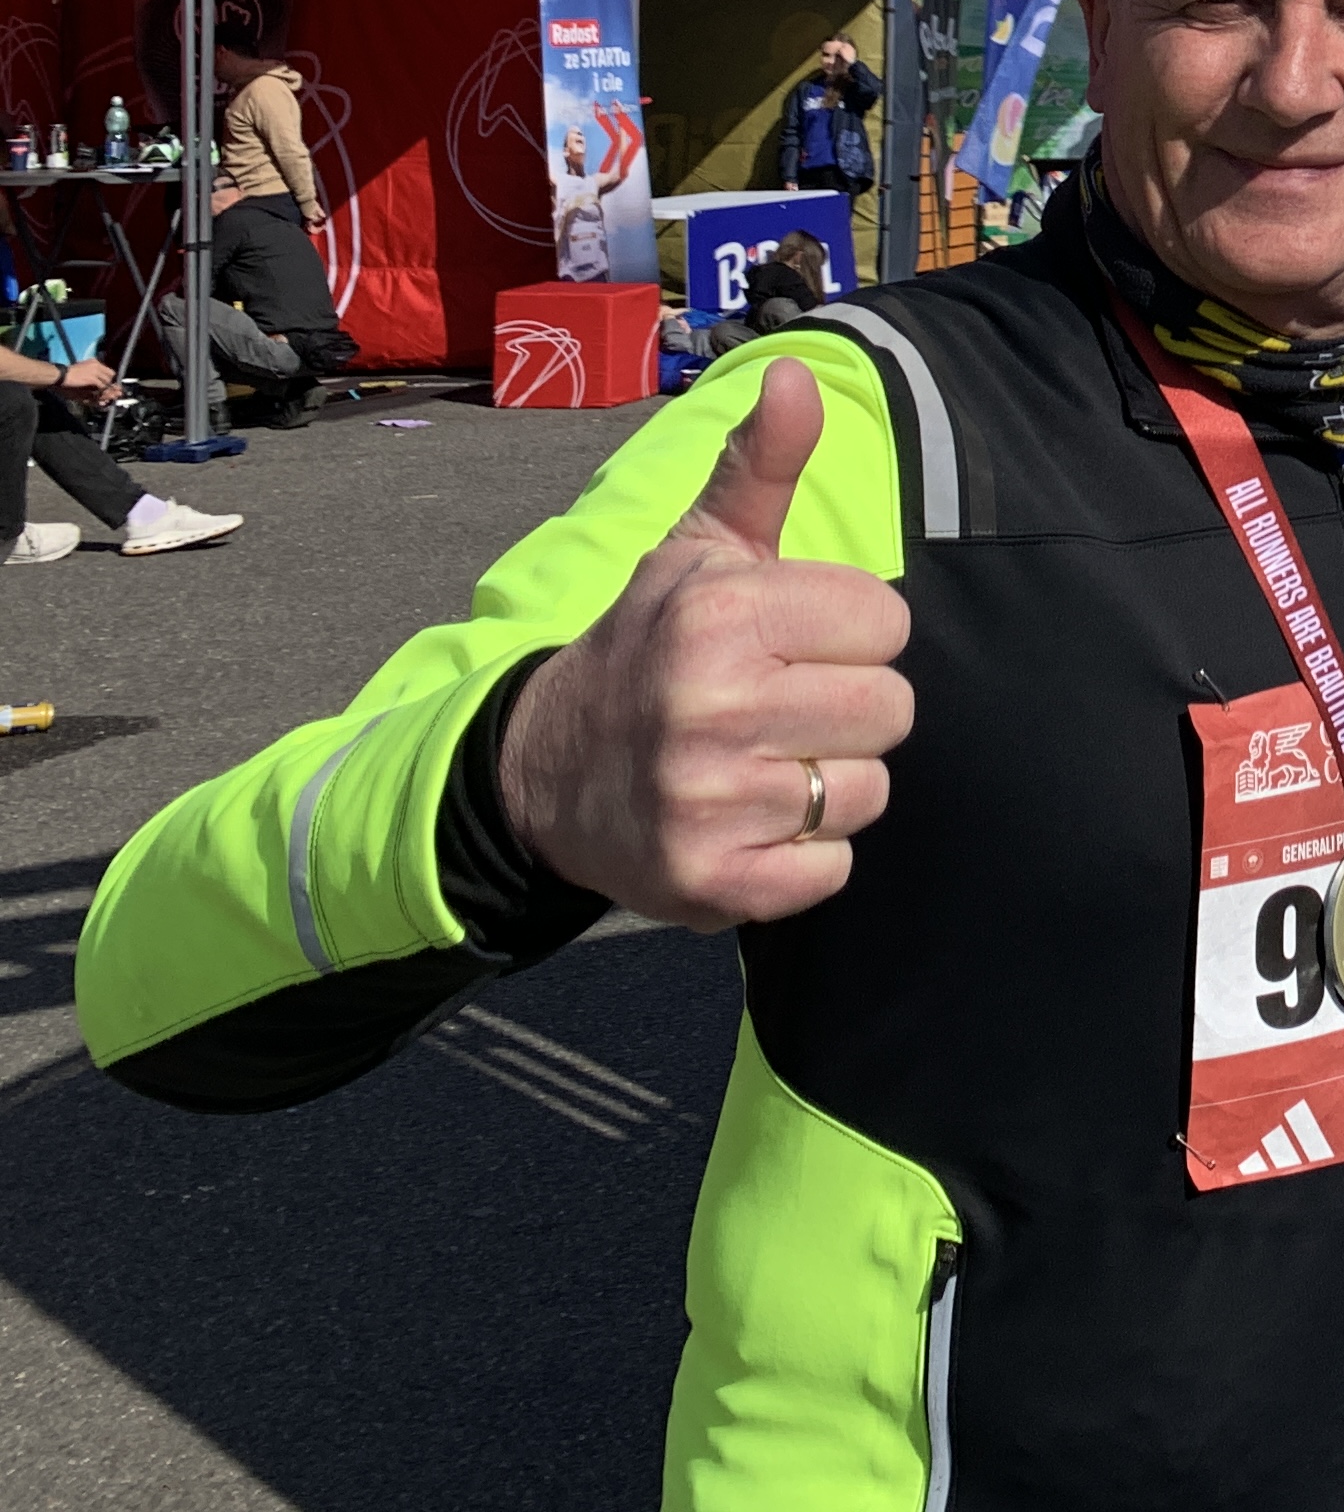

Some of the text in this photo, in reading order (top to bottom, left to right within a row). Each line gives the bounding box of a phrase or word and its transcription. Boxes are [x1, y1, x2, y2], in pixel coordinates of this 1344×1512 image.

[550, 22, 600, 45] Radost
[563, 52, 580, 70] ze
[1225, 476, 1269, 519] ALL
[1242, 510, 1308, 610] RUNNERS
[1285, 604, 1328, 652] ARE
[1282, 838, 1336, 865] GENERALI
